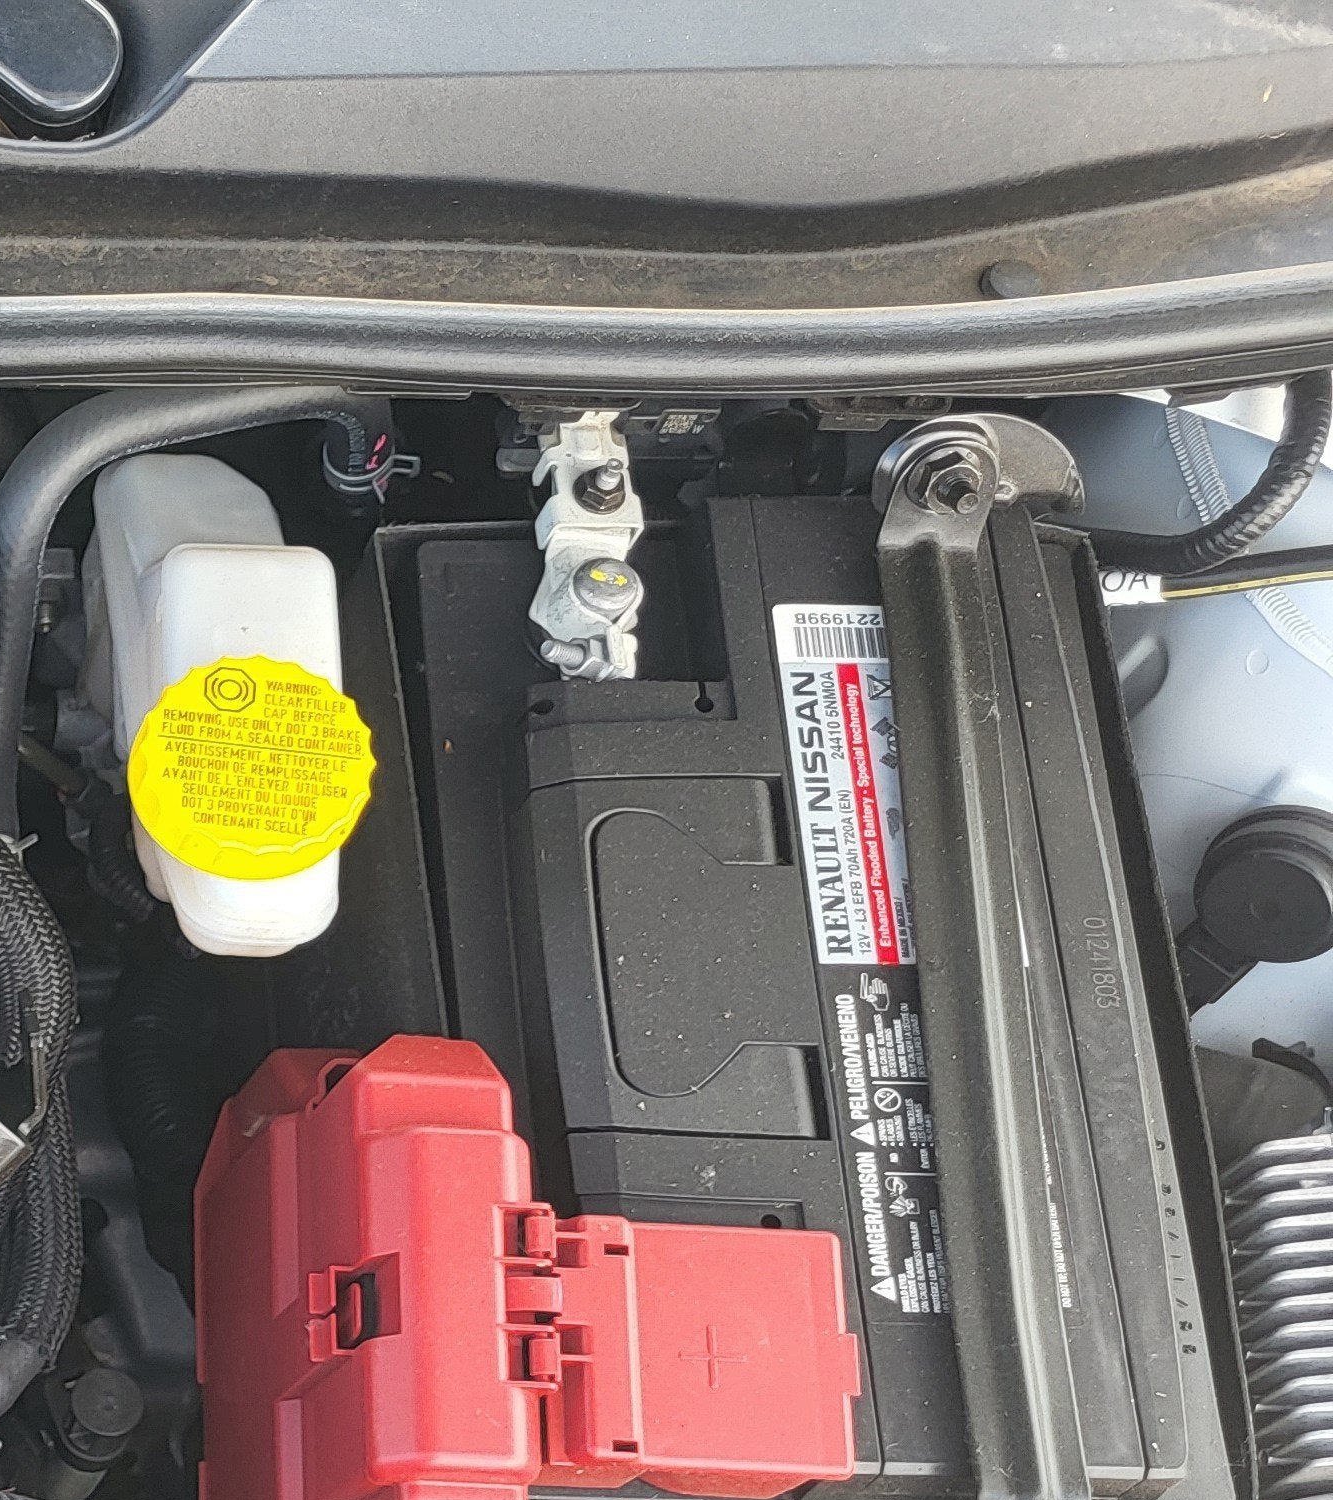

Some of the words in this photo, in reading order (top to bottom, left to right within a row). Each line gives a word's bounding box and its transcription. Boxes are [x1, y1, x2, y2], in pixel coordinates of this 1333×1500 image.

[794, 612, 880, 625] 221999B
[263, 709, 287, 720] CAP
[264, 694, 306, 709] CLEAN
[307, 699, 347, 714] FILLER
[841, 683, 866, 747] technology
[162, 722, 194, 737] FLUID
[199, 727, 232, 740] FROM
[235, 730, 244, 741] A
[247, 732, 293, 747] SEALED
[228, 717, 249, 729] USE
[252, 720, 281, 732] ONLY
[286, 723, 307, 735] DOT
[312, 725, 319, 736] 3
[323, 727, 361, 742] BRAKE
[791, 672, 833, 814] NISSAN
[827, 722, 845, 761] 24410
[163, 767, 203, 783] AVANT
[207, 772, 221, 784] DE
[296, 782, 348, 798] UTILISER
[178, 755, 229, 772] BOUCHON
[233, 762, 246, 773] DE
[251, 764, 332, 784] REMPLISSAGE
[849, 747, 871, 789] Special
[182, 783, 252, 800] SEULEMENT
[255, 791, 269, 802] DU
[274, 794, 318, 809] LIQUIDE
[182, 797, 203, 809] DOT
[207, 800, 214, 810] 3
[218, 800, 286, 818] PROVENANT
[837, 789, 854, 816] (EN)
[193, 812, 260, 829] CONTENANT
[265, 819, 308, 835] SCELLÉ
[840, 817, 857, 847] 720A
[858, 798, 880, 839] Battery
[845, 848, 861, 879] 70Ah
[865, 842, 884, 888] Flooded
[811, 824, 853, 959] RENAULT
[849, 881, 865, 905] EFB
[853, 908, 868, 924] L3
[872, 890, 892, 948] Enhanced
[857, 934, 872, 956] 12V
[1083, 919, 1119, 1008] 01241803
[835, 995, 870, 1122] PELIGRO/VENENO
[854, 1152, 890, 1278] DANGER/POISON
